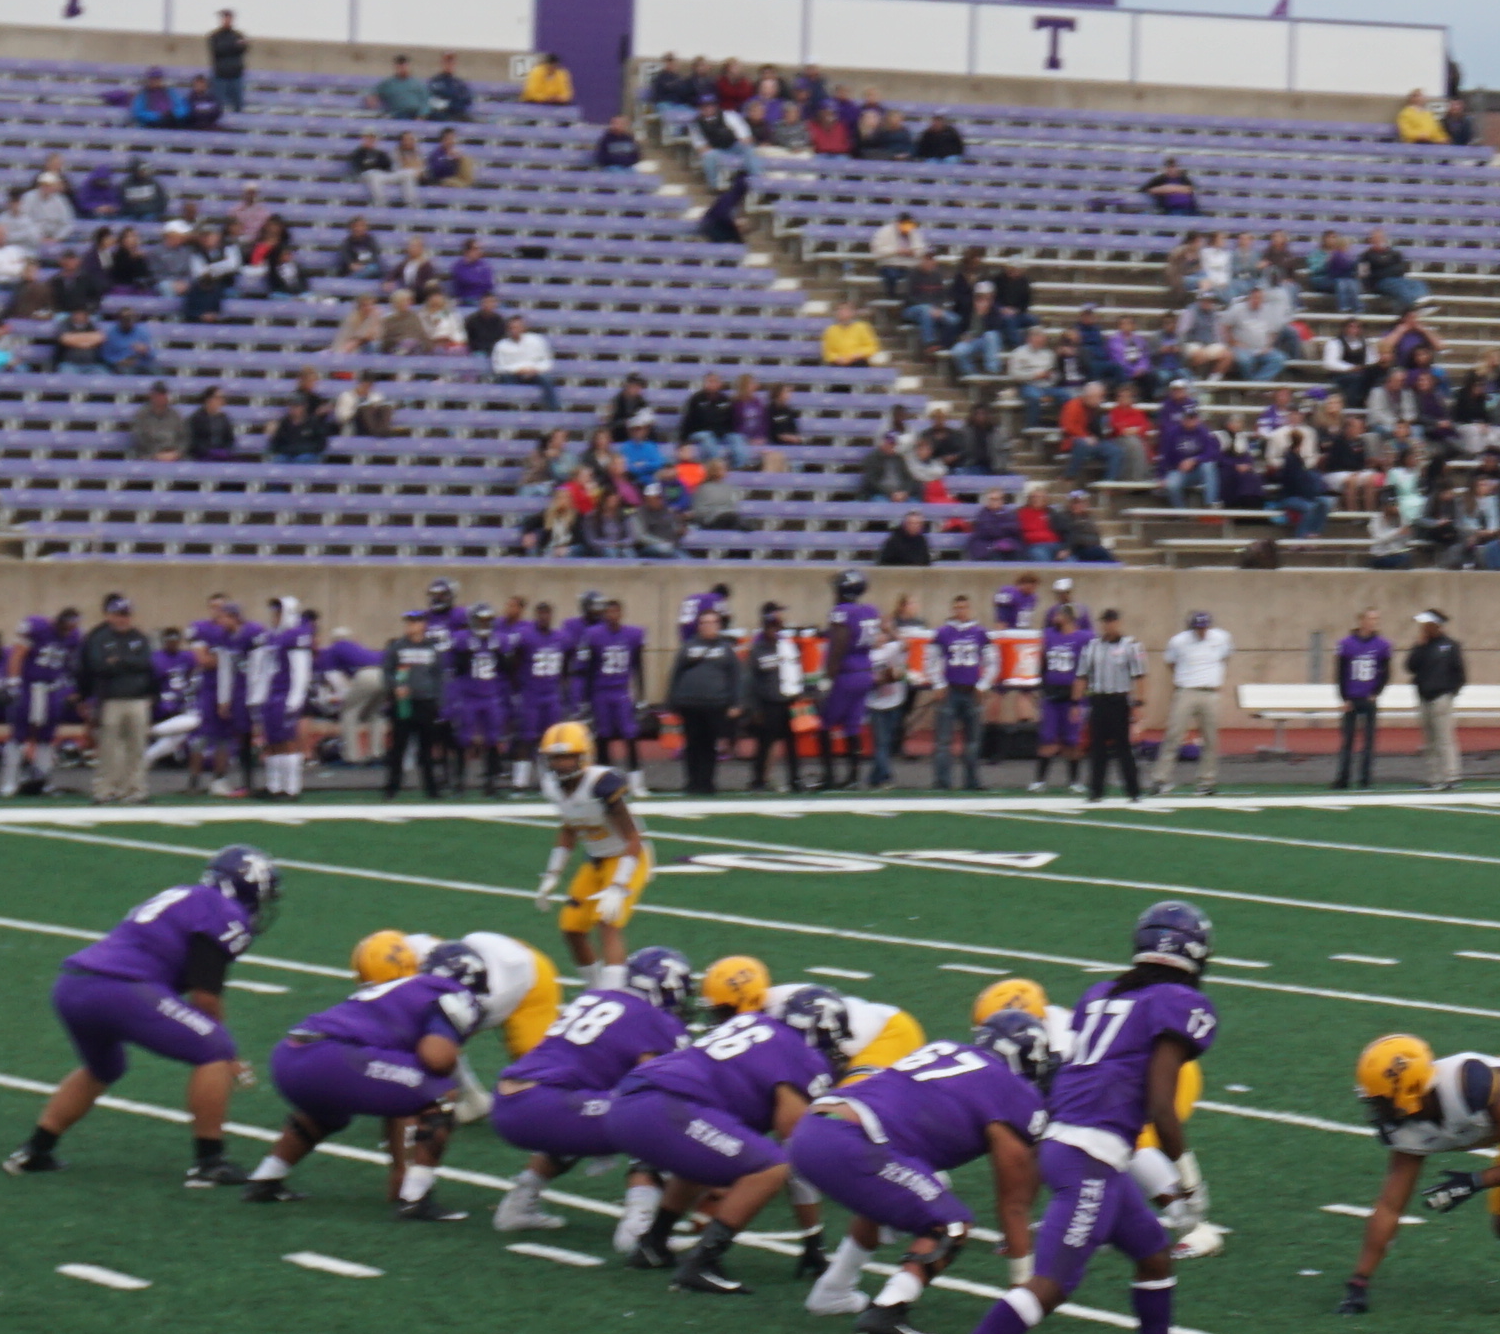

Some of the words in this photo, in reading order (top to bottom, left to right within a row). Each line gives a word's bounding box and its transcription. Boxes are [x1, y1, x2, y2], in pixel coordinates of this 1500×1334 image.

[545, 995, 626, 1045] 58
[692, 1014, 775, 1062] 66
[1072, 999, 1137, 1067] 17
[890, 1039, 990, 1082] 67
[1063, 1178, 1107, 1249] TEXANS
